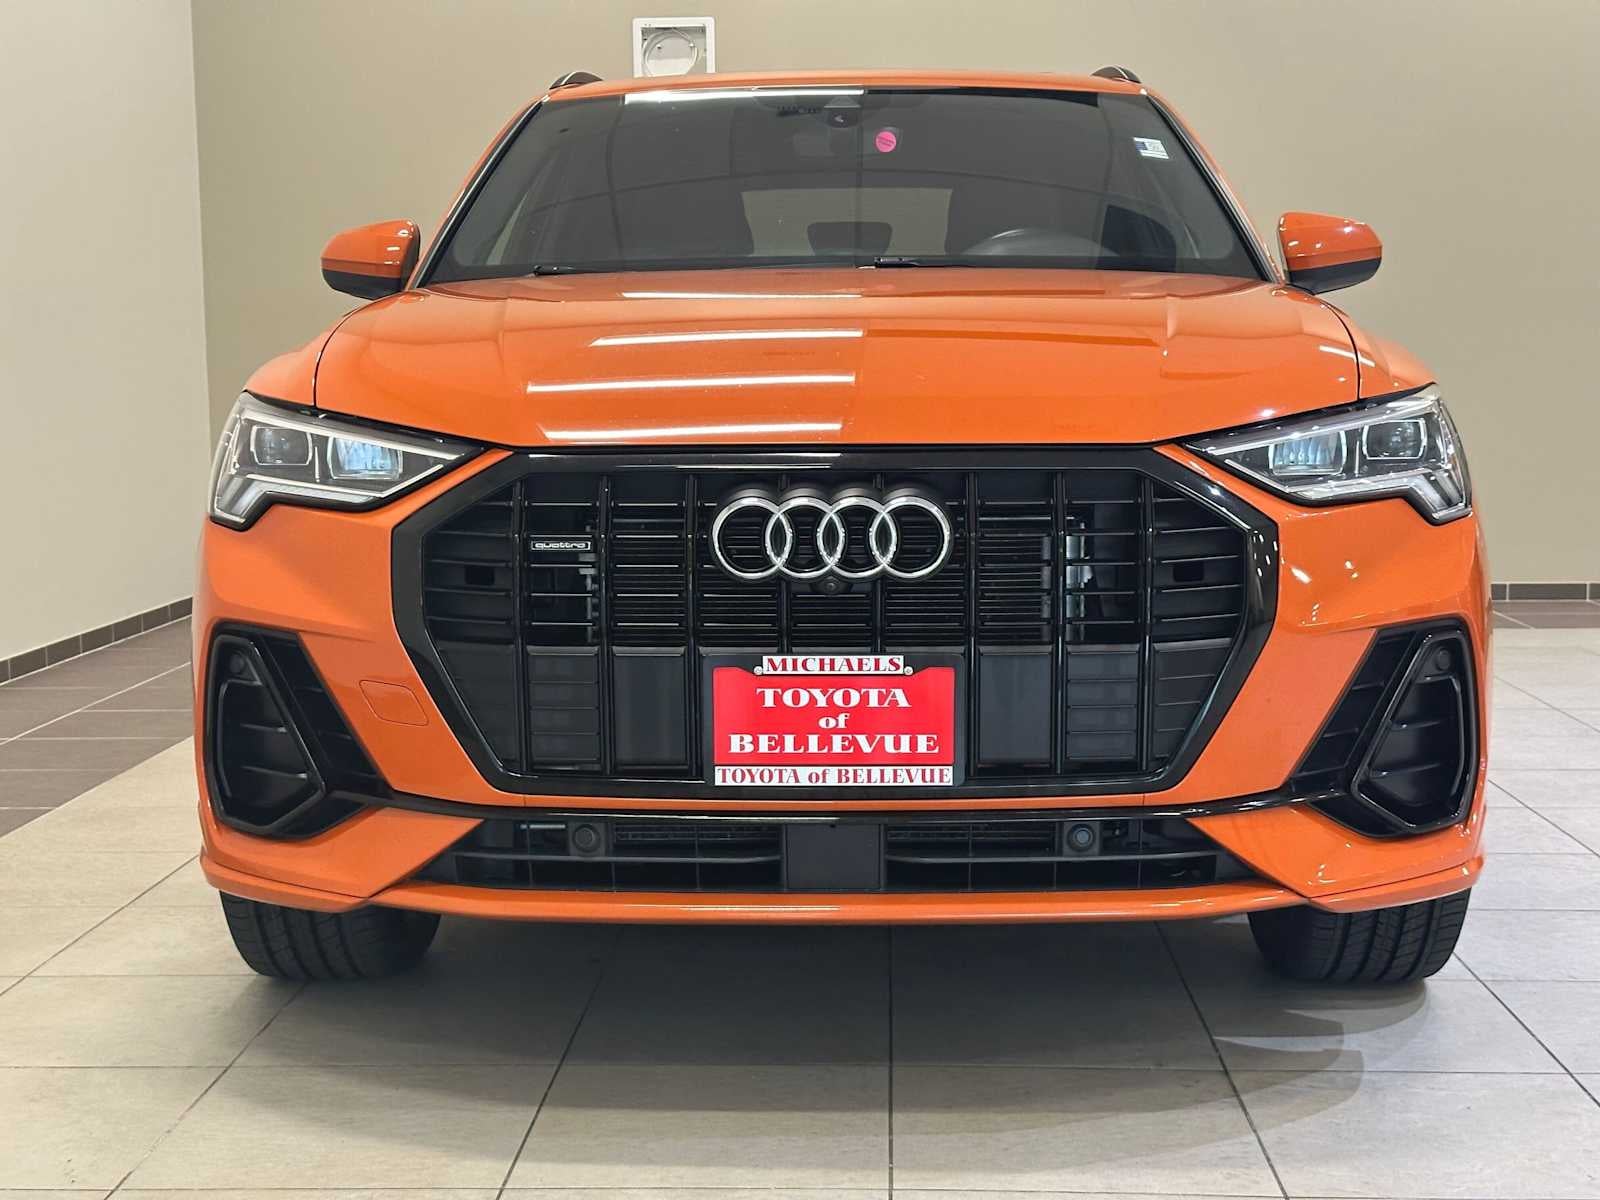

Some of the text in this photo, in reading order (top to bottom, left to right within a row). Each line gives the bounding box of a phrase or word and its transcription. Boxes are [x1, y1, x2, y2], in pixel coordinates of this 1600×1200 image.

[535, 542, 586, 550] quattro
[766, 657, 901, 672] MICHAELS
[756, 687, 912, 708] TOYOTA
[818, 712, 850, 729] of
[728, 733, 940, 754] BELLEVUE
[717, 768, 951, 784] TOYOTA of BELLEVUE
